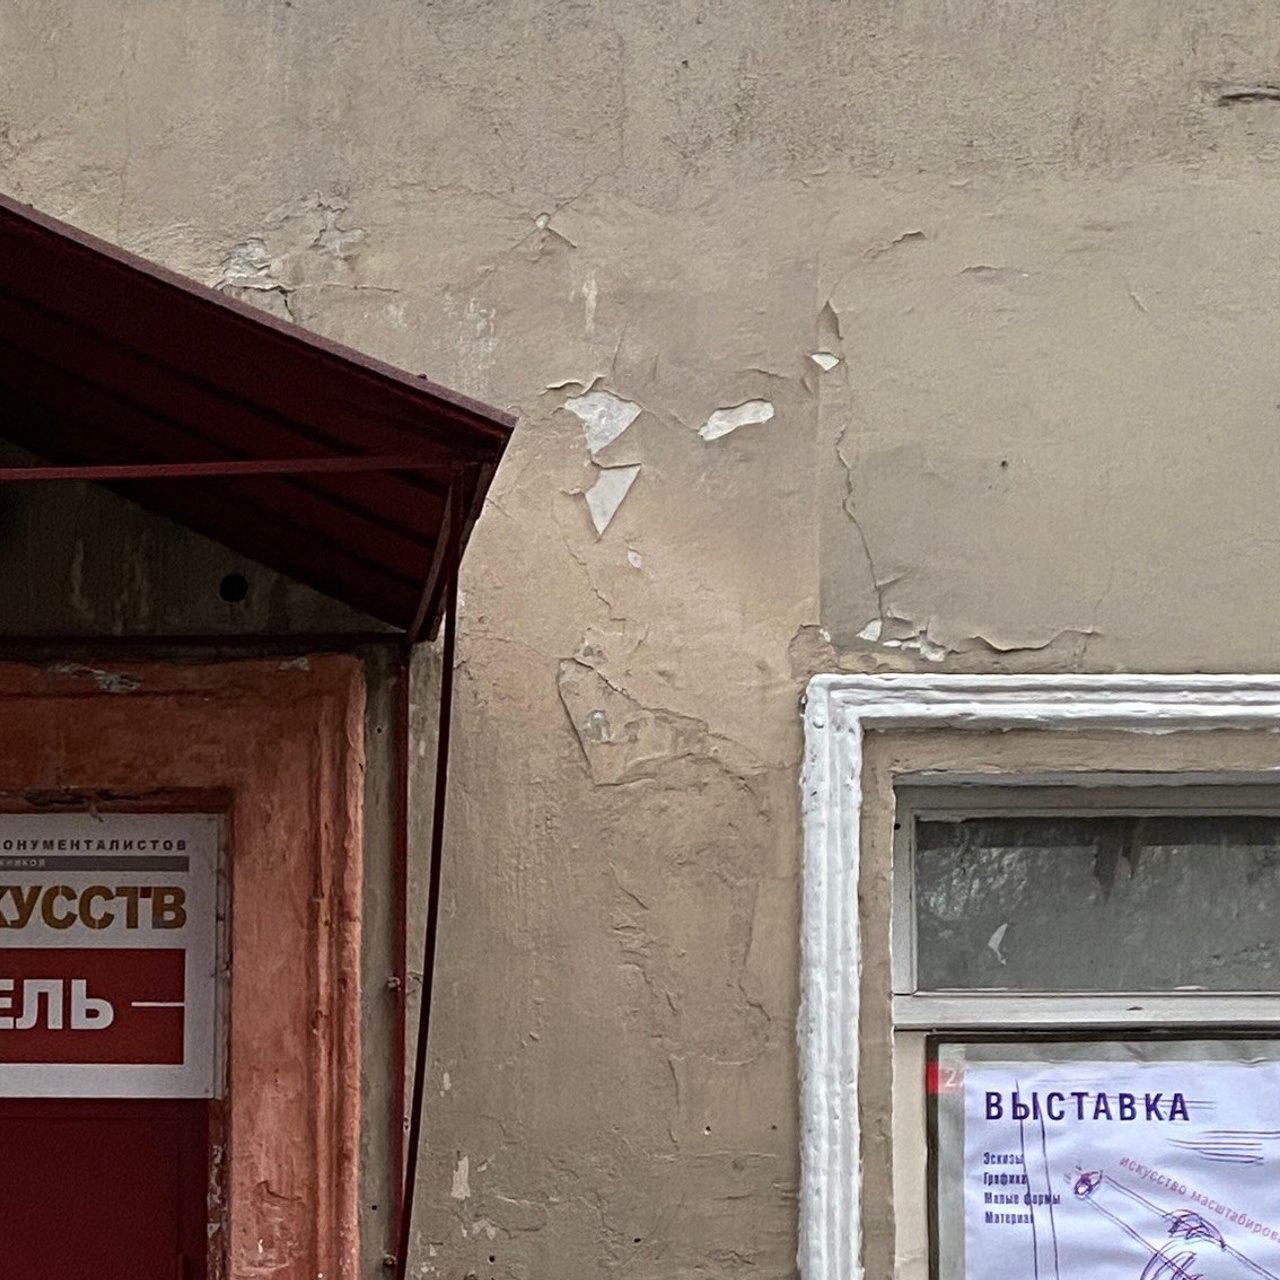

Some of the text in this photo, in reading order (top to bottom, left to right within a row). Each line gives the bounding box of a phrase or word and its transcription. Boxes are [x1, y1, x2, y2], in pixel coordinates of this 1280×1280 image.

[985, 1092, 1191, 1121] ВЫСТАВКА
[983, 1152, 1025, 1165] Эскизы
[984, 1192, 1019, 1205] Малые
[1119, 1156, 1280, 1244] искусство масштабиров
